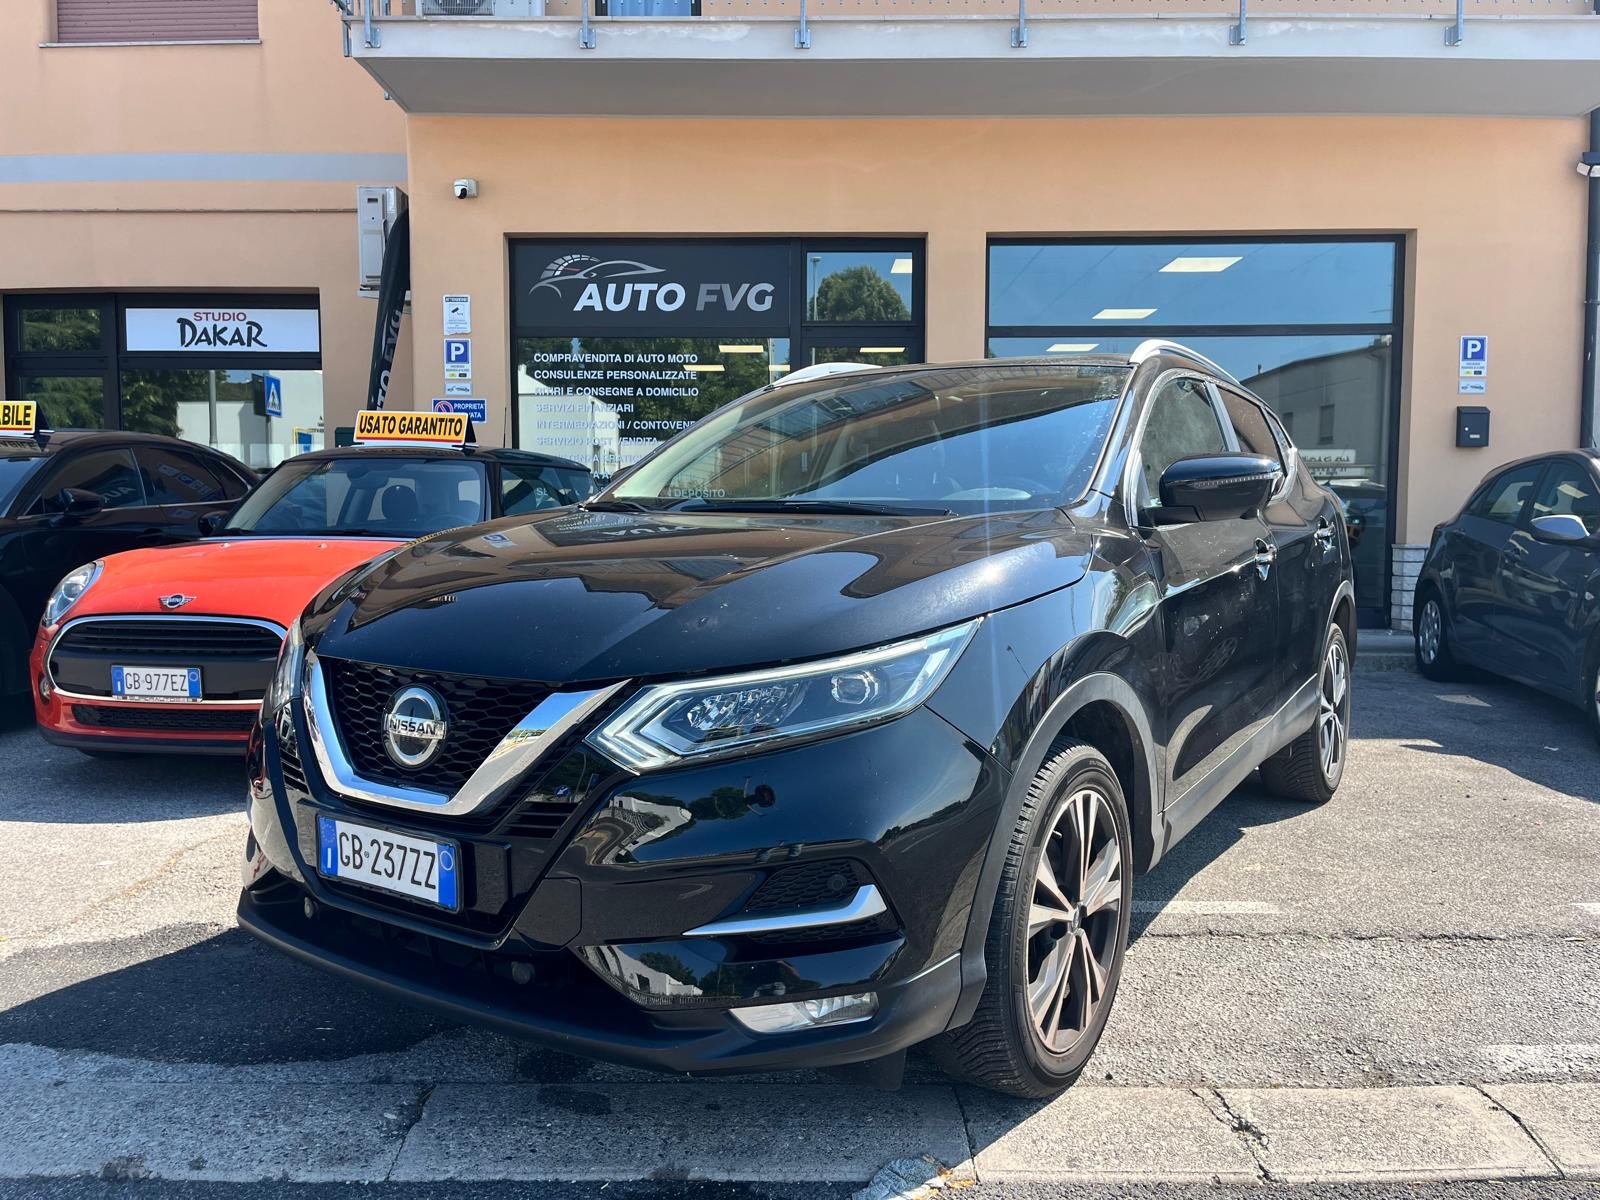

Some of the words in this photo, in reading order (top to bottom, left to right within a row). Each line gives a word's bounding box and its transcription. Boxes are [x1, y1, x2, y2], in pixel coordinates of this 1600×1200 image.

[573, 283, 686, 312] AUTO
[695, 283, 776, 312] FVG
[193, 311, 247, 322] STUDIO
[176, 317, 268, 348] DAKAR
[451, 342, 465, 361] P
[1467, 339, 1481, 359] P
[533, 353, 622, 363] COMPRAVENDITA
[624, 354, 635, 363] DI
[636, 354, 665, 363] AUTO
[667, 354, 698, 363] MOTO
[534, 370, 604, 380] CONSULENZE
[606, 370, 698, 380] PERSONALIZZATE
[566, 387, 574, 396] E
[576, 387, 634, 397] CONSEGNE
[635, 387, 644, 396] A
[646, 387, 699, 397] DOMICILIO
[0, 405, 32, 425] BILE
[535, 403, 575, 413] SERVIZI
[359, 414, 397, 434] USATO
[398, 416, 463, 437] GARANTITO
[617, 437, 658, 446] VENDITA
[674, 488, 726, 498] DEPOSITO
[388, 718, 437, 736] NISSAN
